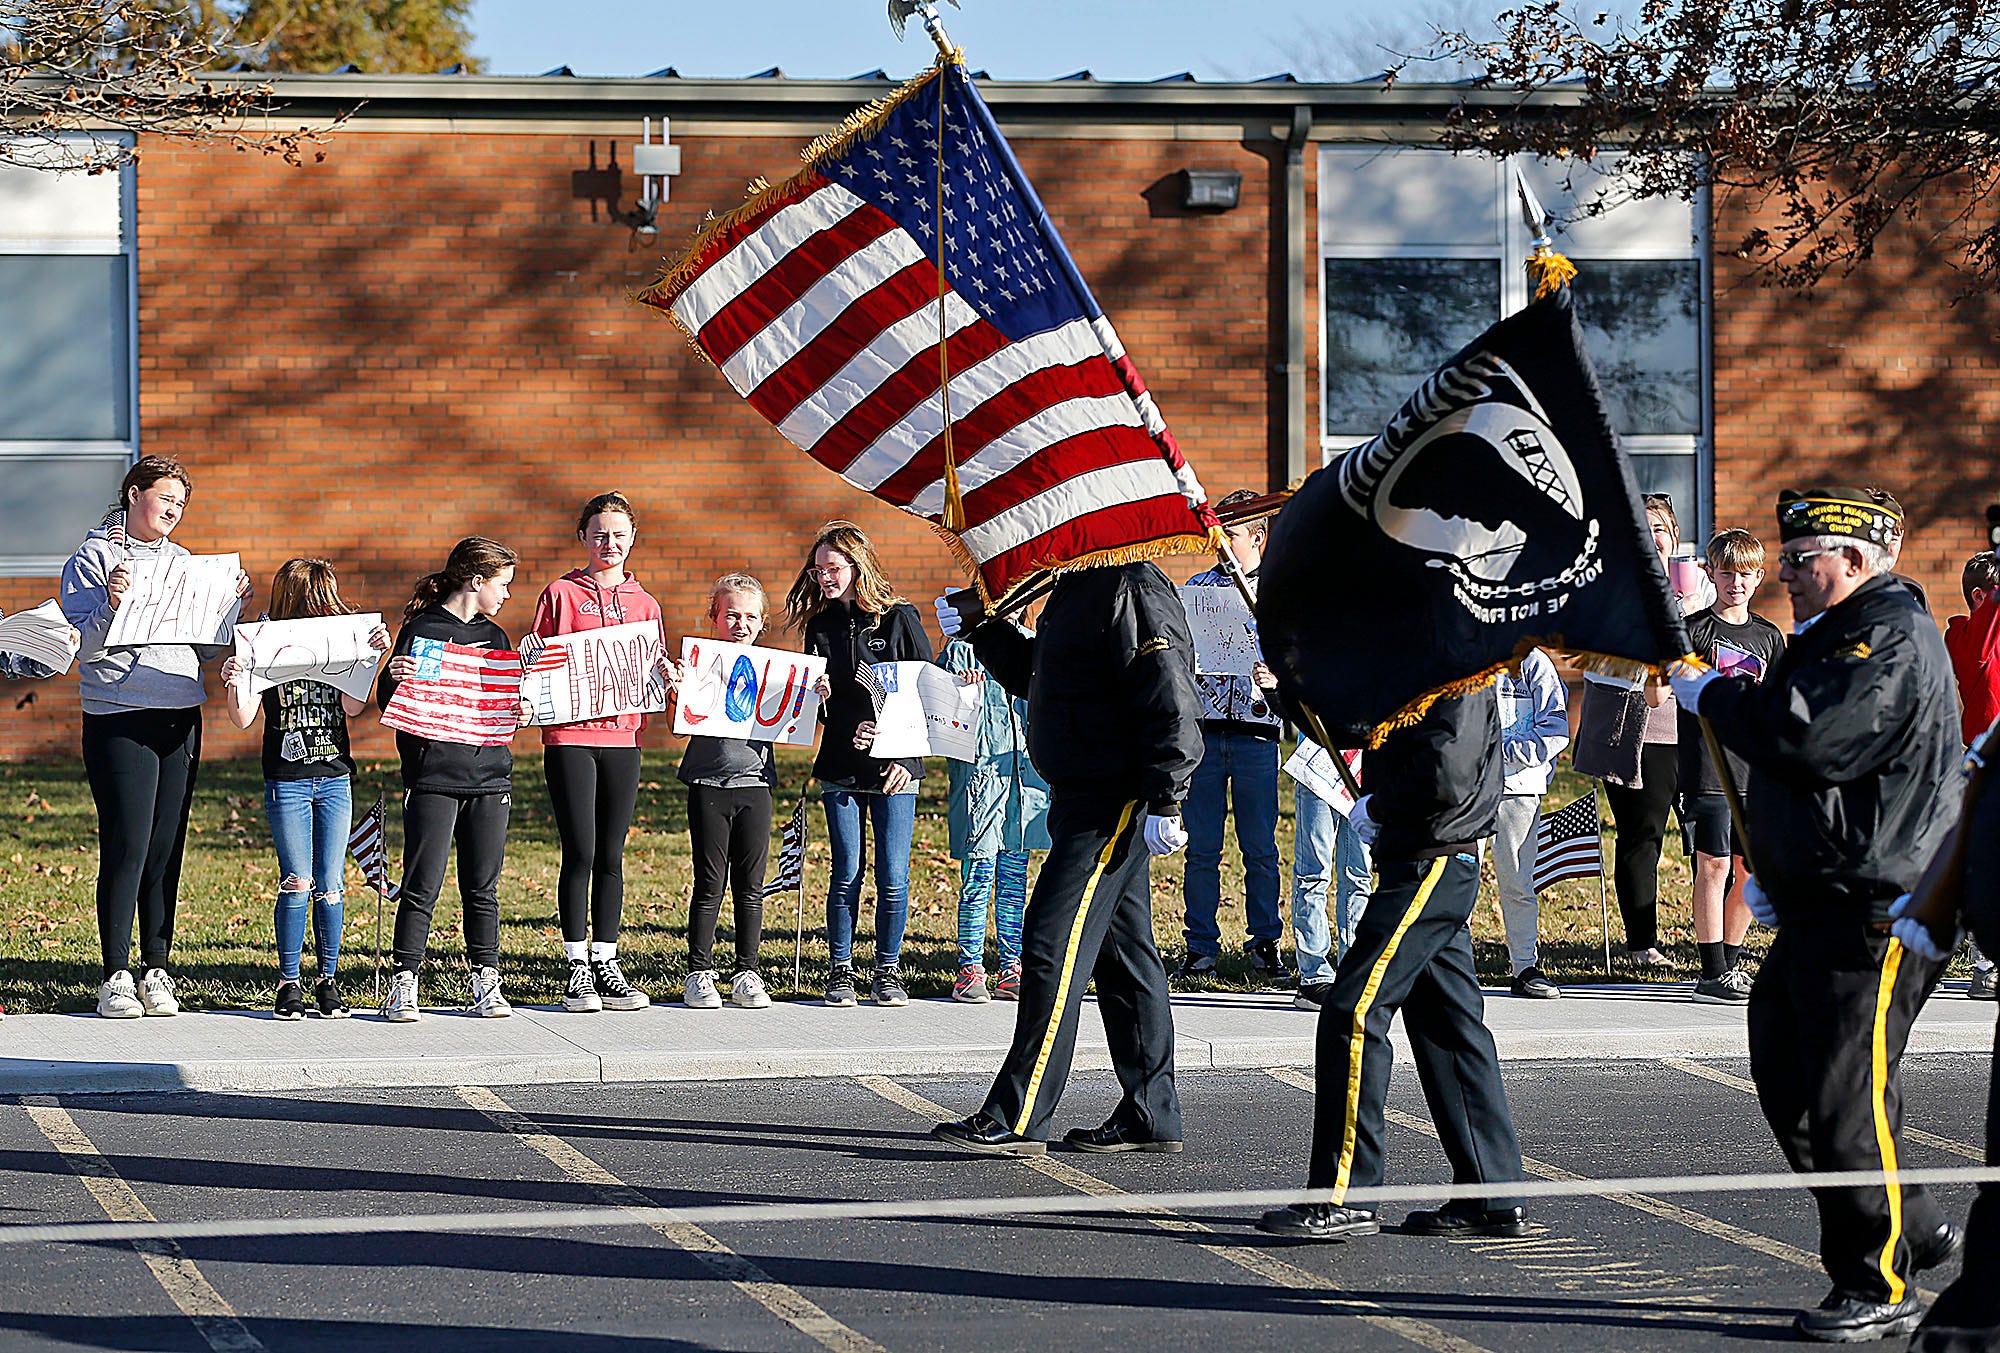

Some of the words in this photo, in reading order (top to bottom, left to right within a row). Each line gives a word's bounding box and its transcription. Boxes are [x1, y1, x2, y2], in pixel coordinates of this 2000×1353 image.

[1807, 504, 1842, 518] HONOR
[1842, 506, 1873, 525] GUARD
[1819, 514, 1862, 528] ASHLAND
[1828, 523, 1853, 535] OHIO
[682, 644, 811, 734] YOU!
